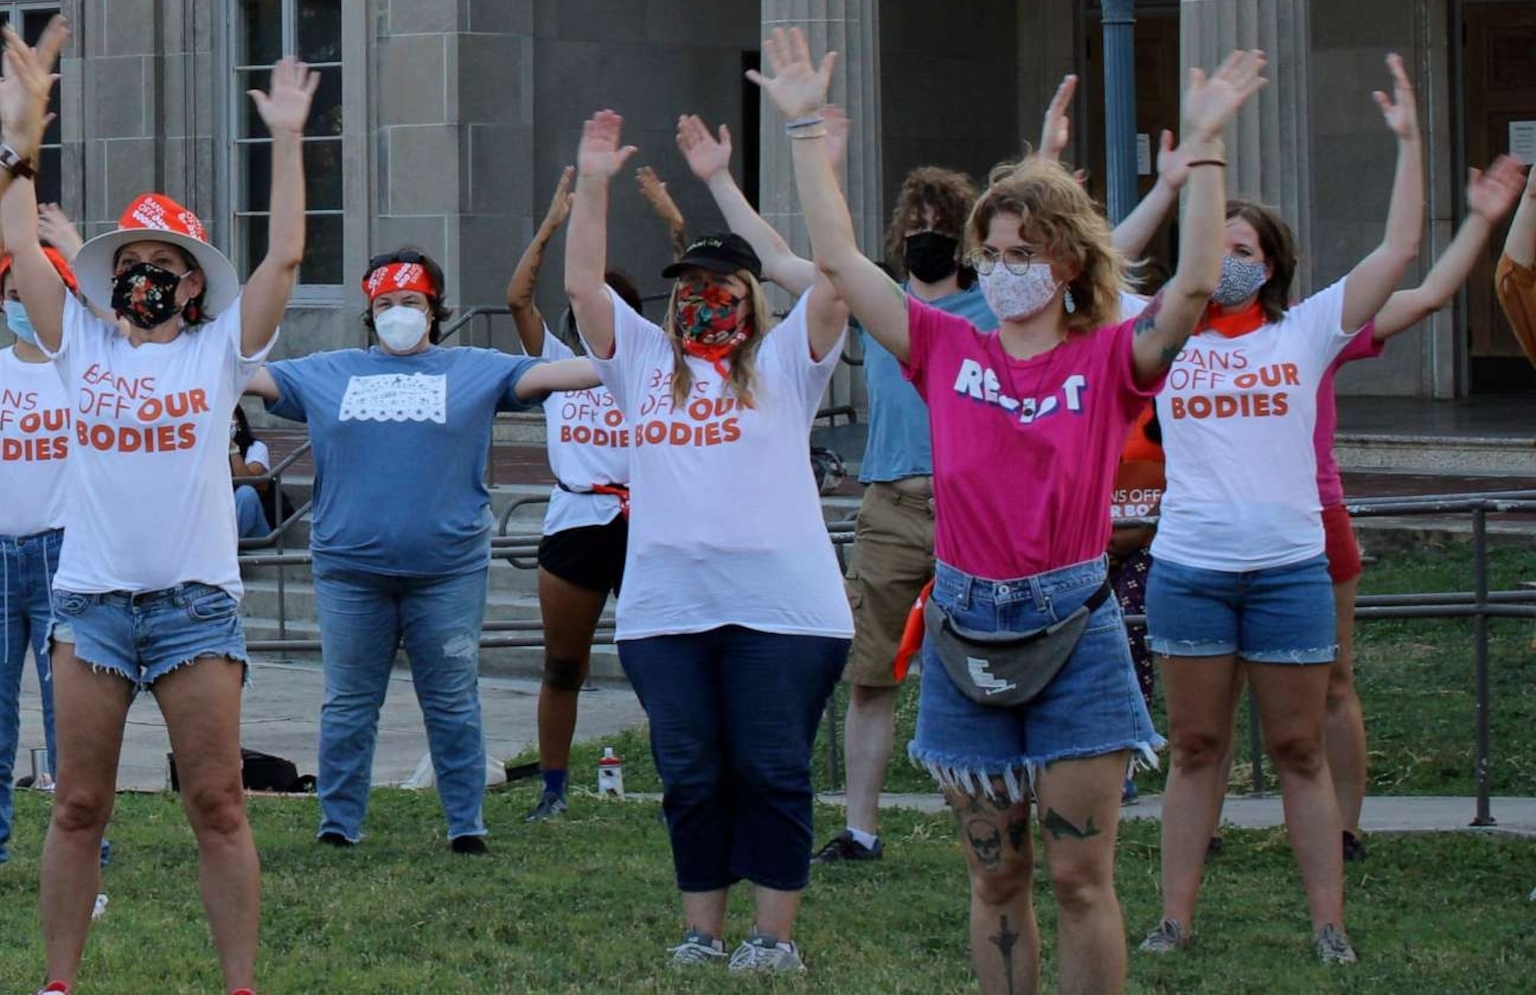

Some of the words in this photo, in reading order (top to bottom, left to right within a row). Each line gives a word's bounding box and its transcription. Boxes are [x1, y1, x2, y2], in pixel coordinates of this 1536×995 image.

[1170, 368, 1226, 390] OFF
[1234, 362, 1300, 388] OUR
[79, 387, 131, 419] OFF
[137, 388, 210, 421] OUR
[1171, 392, 1289, 419] BODIES
[76, 420, 196, 453] BODIES
[561, 425, 629, 447] BODIE
[1111, 489, 1127, 503] NS
[1130, 489, 1161, 503] OFF
